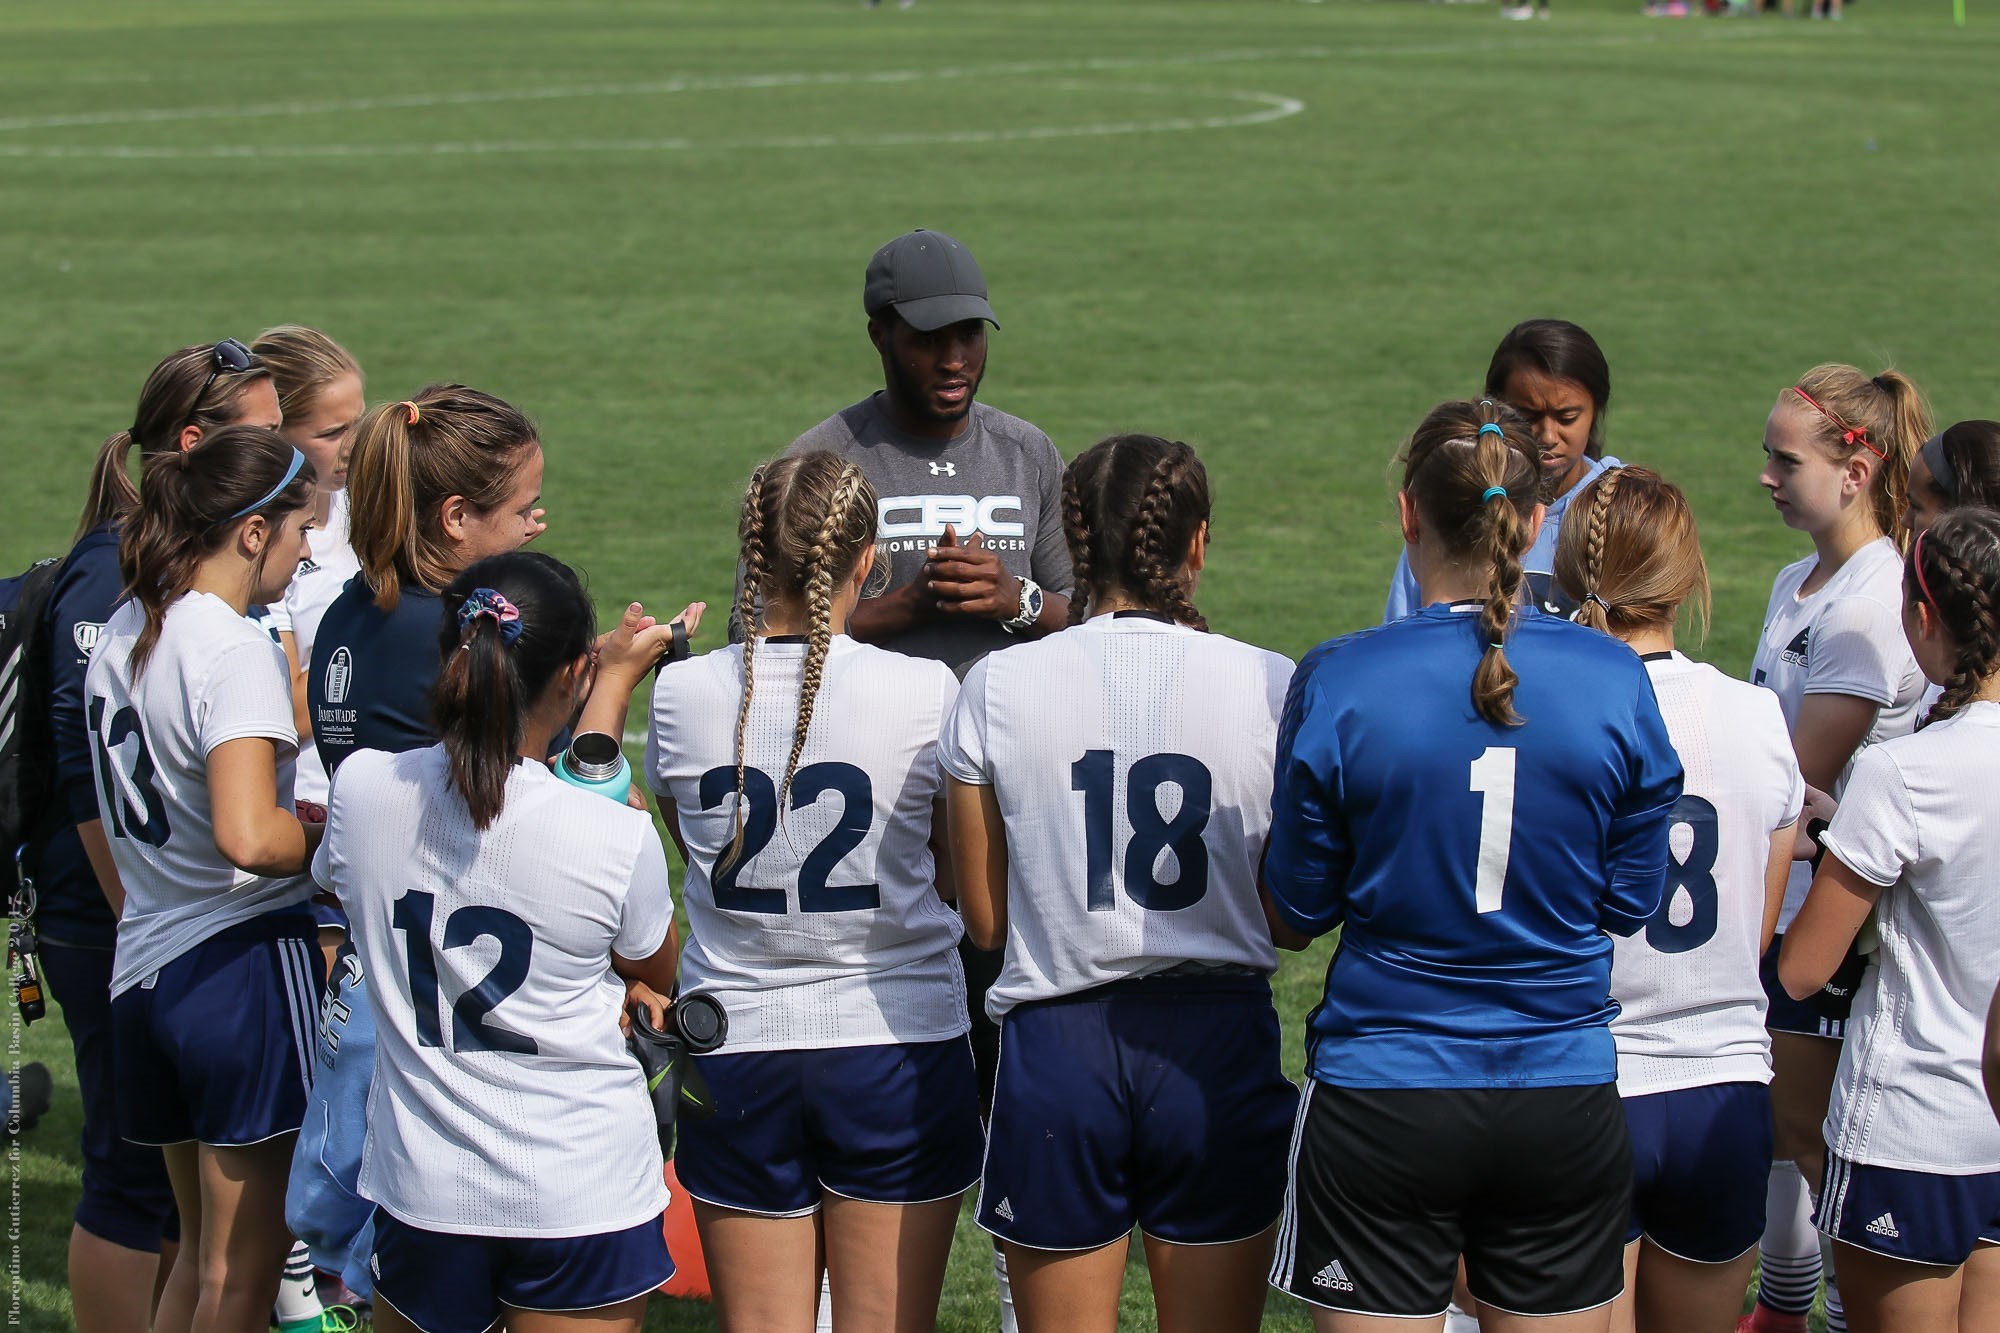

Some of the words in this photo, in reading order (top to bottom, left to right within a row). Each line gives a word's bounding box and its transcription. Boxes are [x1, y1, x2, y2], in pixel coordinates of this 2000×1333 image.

[877, 494, 1025, 539] CBC
[964, 540, 1026, 551] CCER
[335, 708, 357, 723] WADE
[88, 695, 172, 850] 13
[699, 761, 881, 915] 22
[1071, 749, 1212, 912] 18
[1469, 746, 1517, 914] 1
[393, 888, 539, 1056] 12
[1865, 1222, 1900, 1238] adidas
[1312, 1274, 1354, 1292] adidas
